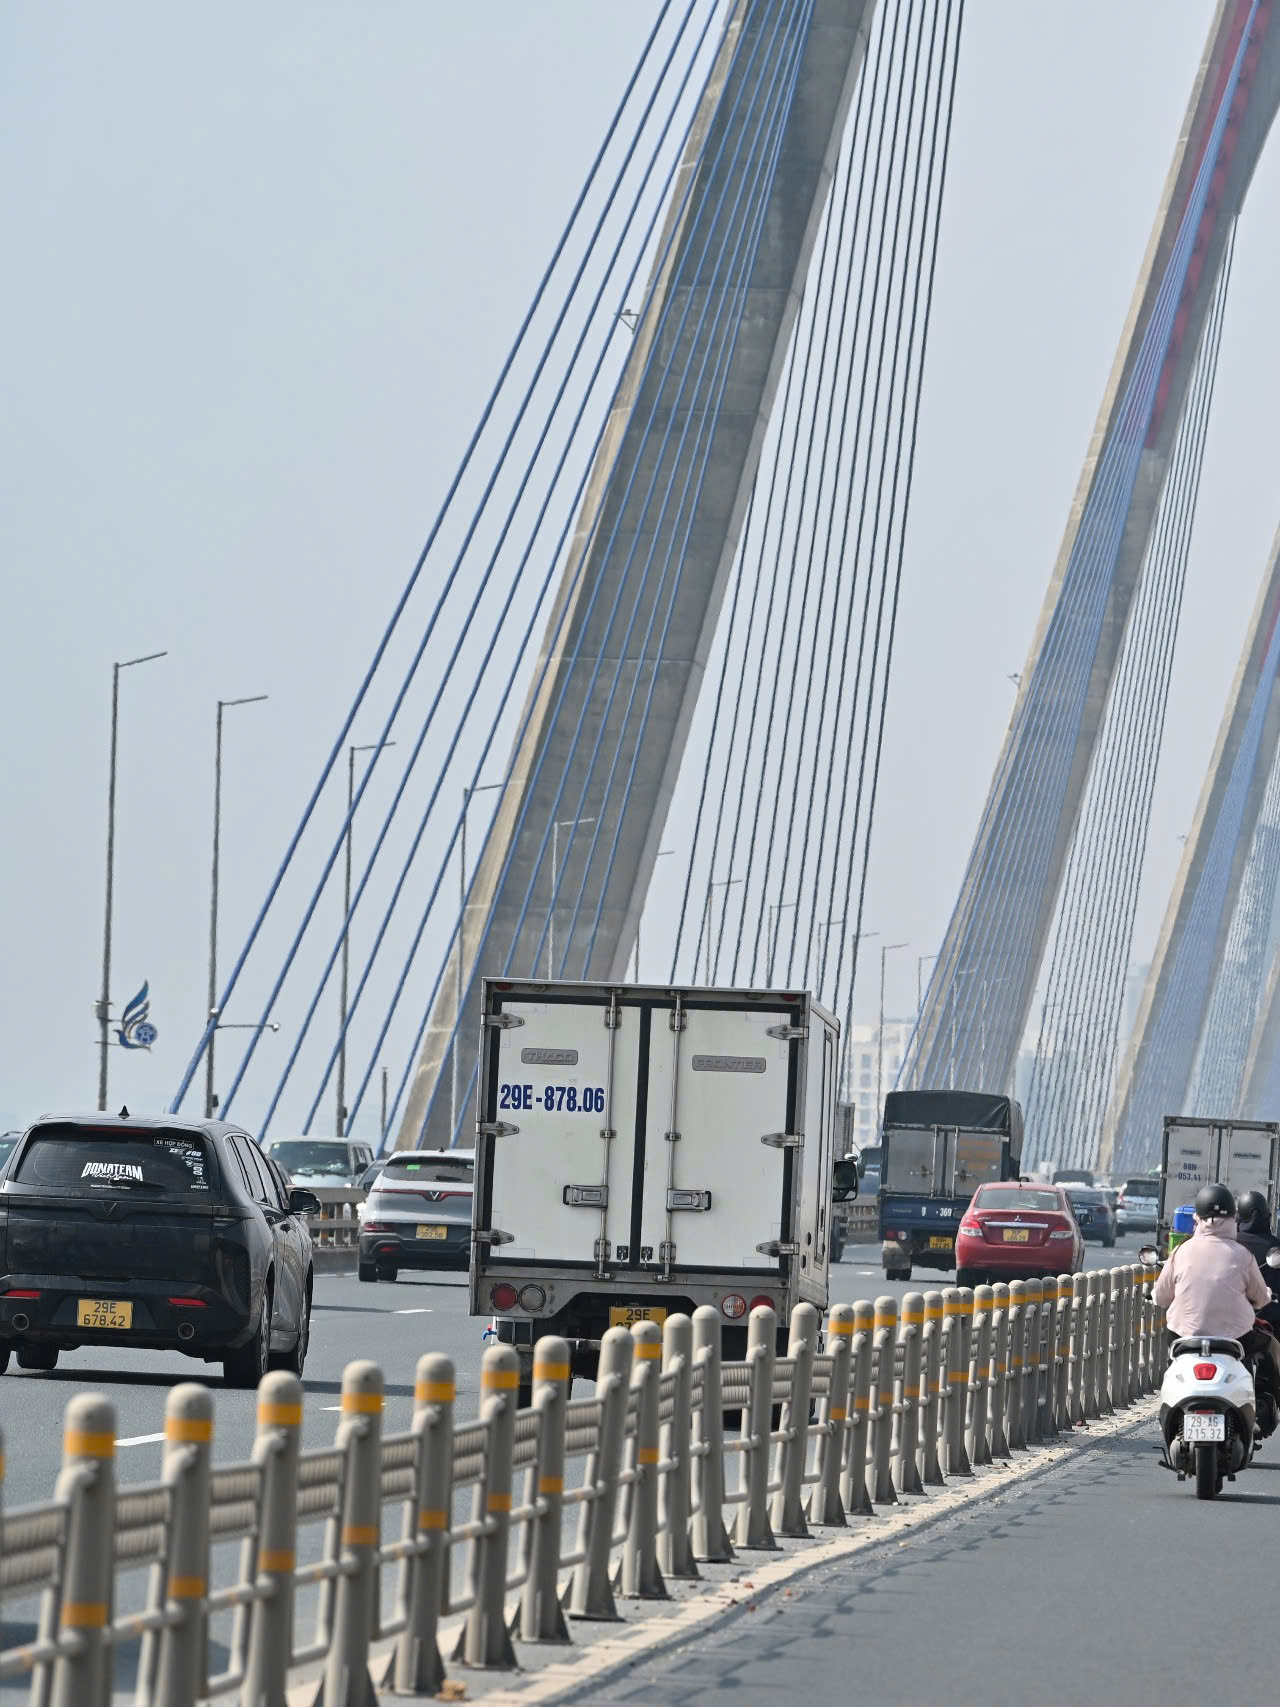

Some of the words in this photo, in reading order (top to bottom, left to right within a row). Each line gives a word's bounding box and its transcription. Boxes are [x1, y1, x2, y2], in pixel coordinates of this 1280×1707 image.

[500, 1084, 605, 1113] 29E-878.06
[93, 1302, 117, 1313] 29E
[83, 1314, 126, 1327] 678.42
[626, 1309, 651, 1321] 29E
